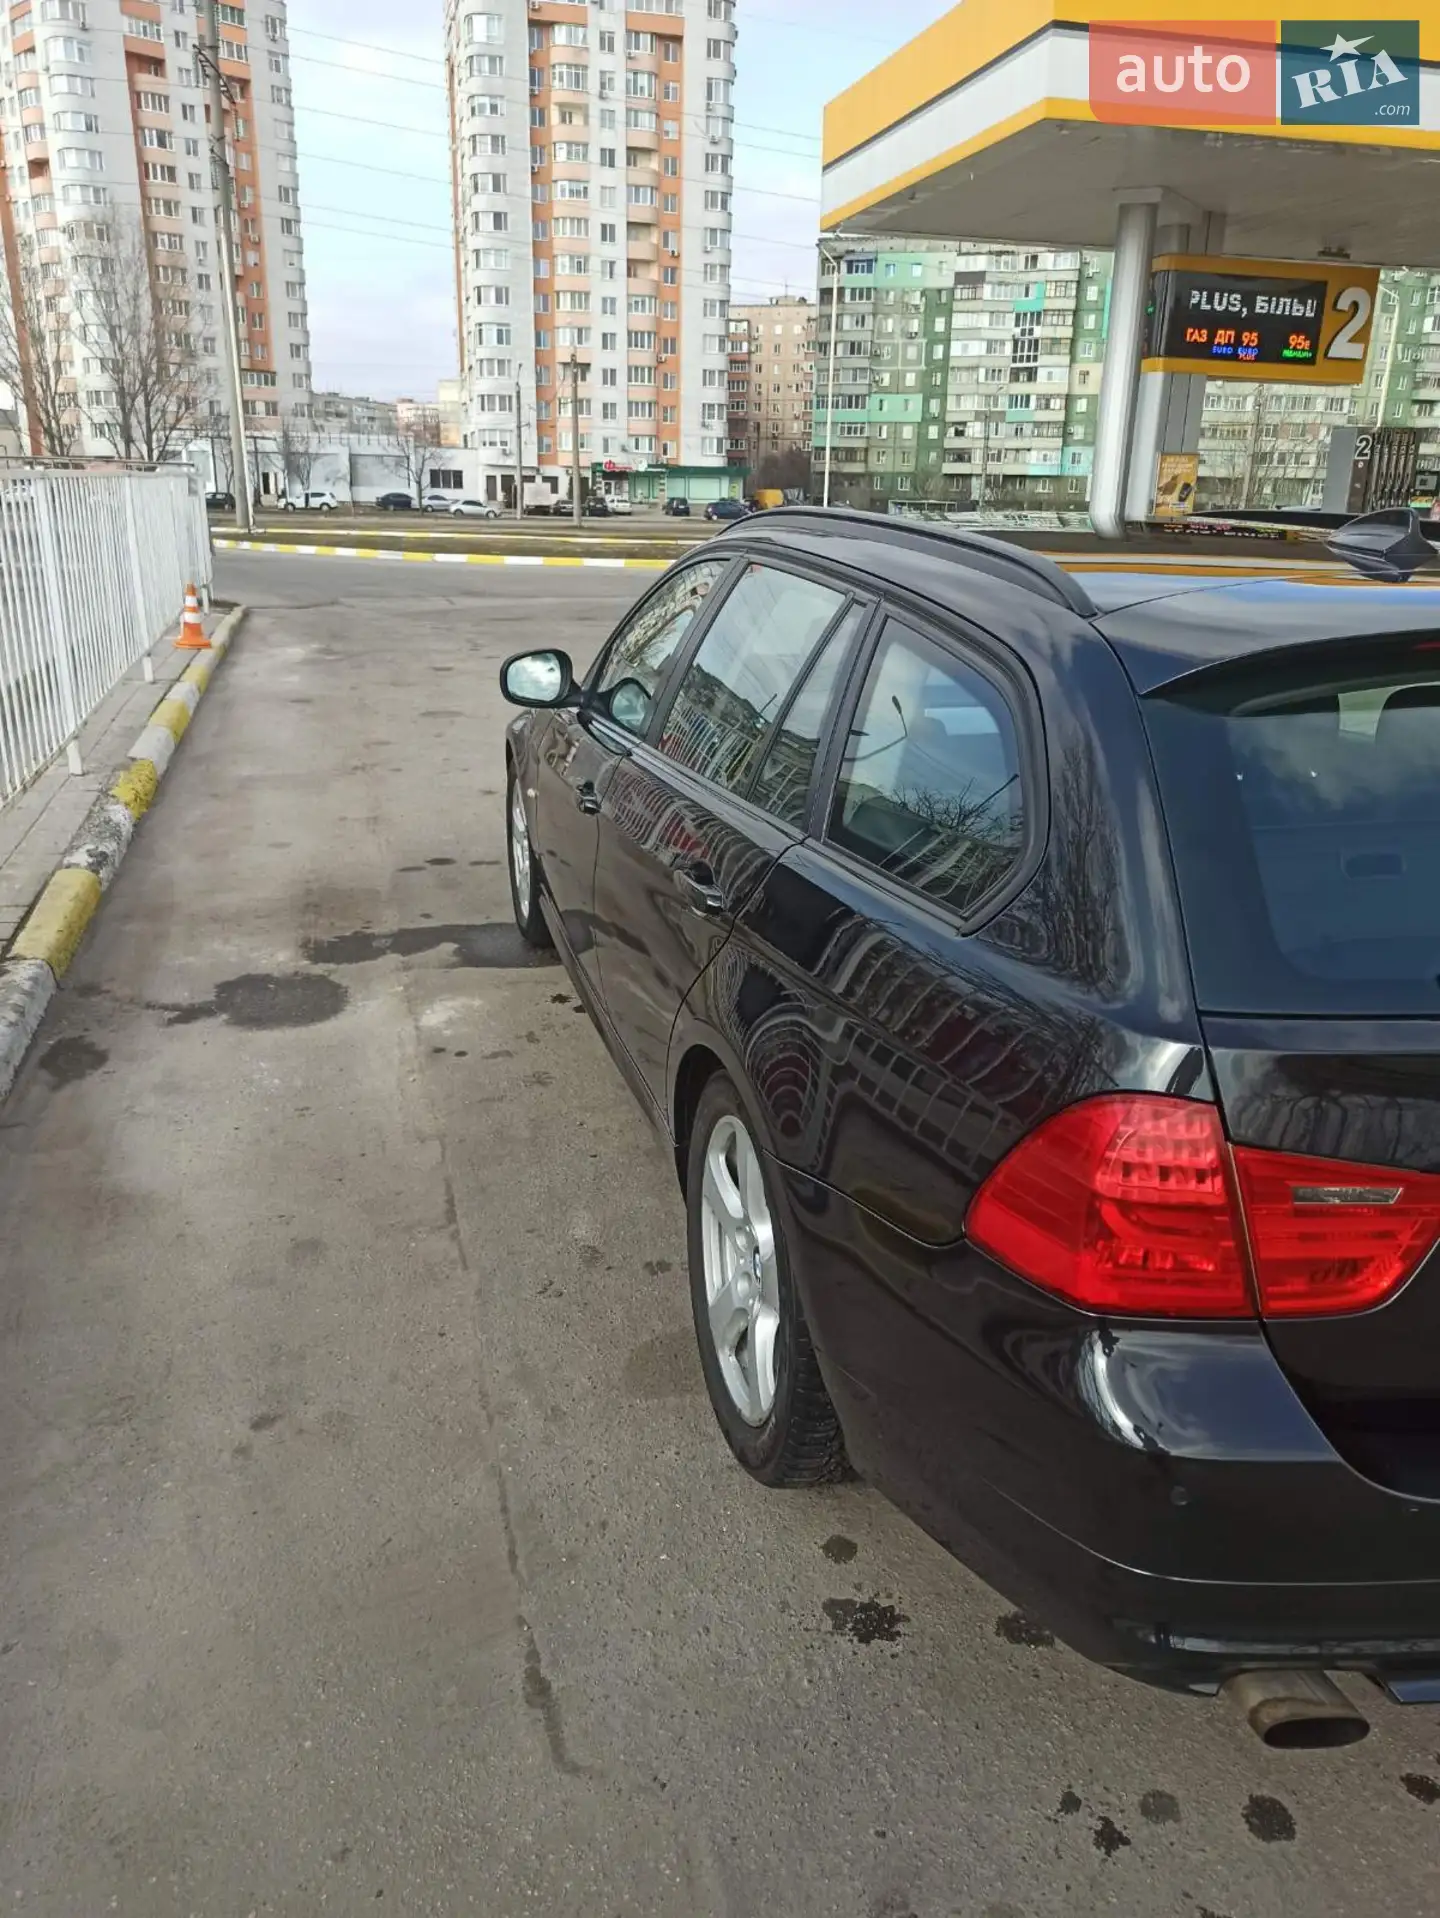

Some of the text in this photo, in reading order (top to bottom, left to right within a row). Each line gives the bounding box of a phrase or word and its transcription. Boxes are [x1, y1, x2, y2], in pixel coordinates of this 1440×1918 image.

[1189, 290, 1248, 318] PLUS,
[1327, 286, 1371, 360] 2
[1186, 327, 1208, 343] ГАЗ
[1213, 329, 1236, 346] ДП
[1241, 331, 1259, 347] 95
[1354, 434, 1373, 460] 2
